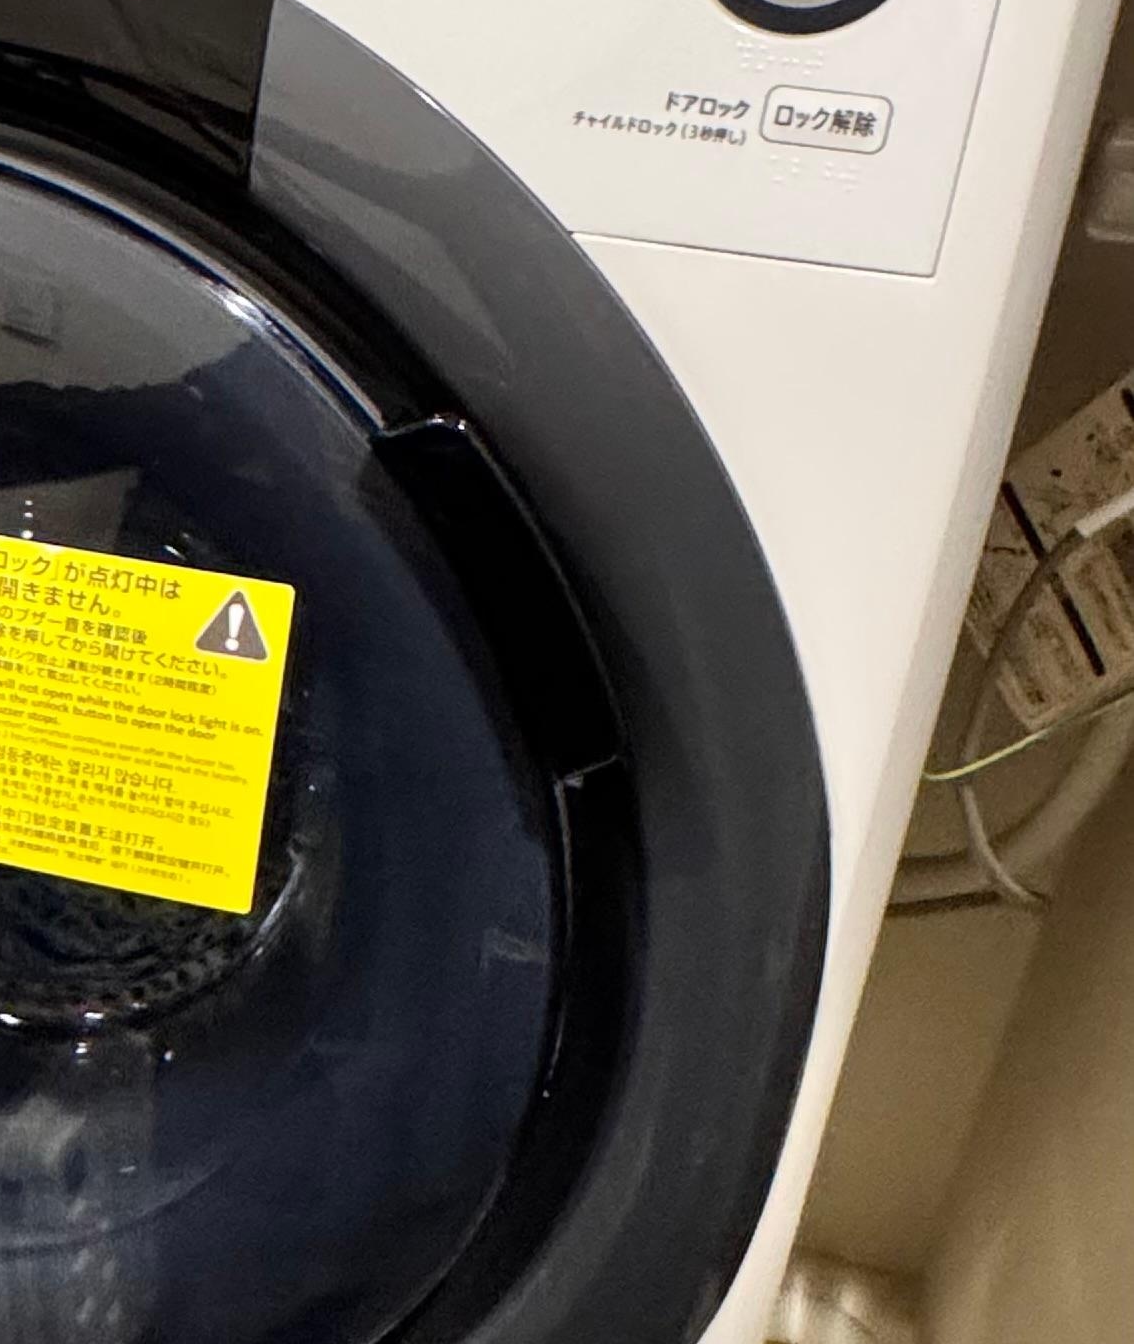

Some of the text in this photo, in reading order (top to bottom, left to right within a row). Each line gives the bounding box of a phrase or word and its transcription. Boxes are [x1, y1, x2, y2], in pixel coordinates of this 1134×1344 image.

[665, 91, 750, 119] ドアロック
[774, 105, 877, 137] ロック解除
[18, 679, 39, 695] not
[40, 683, 73, 701] open
[112, 697, 134, 713] the
[136, 701, 167, 719] door
[168, 707, 197, 725] lock
[197, 713, 227, 731] light
[228, 719, 241, 734] is
[163, 721, 185, 736] the
[186, 725, 217, 742] door
